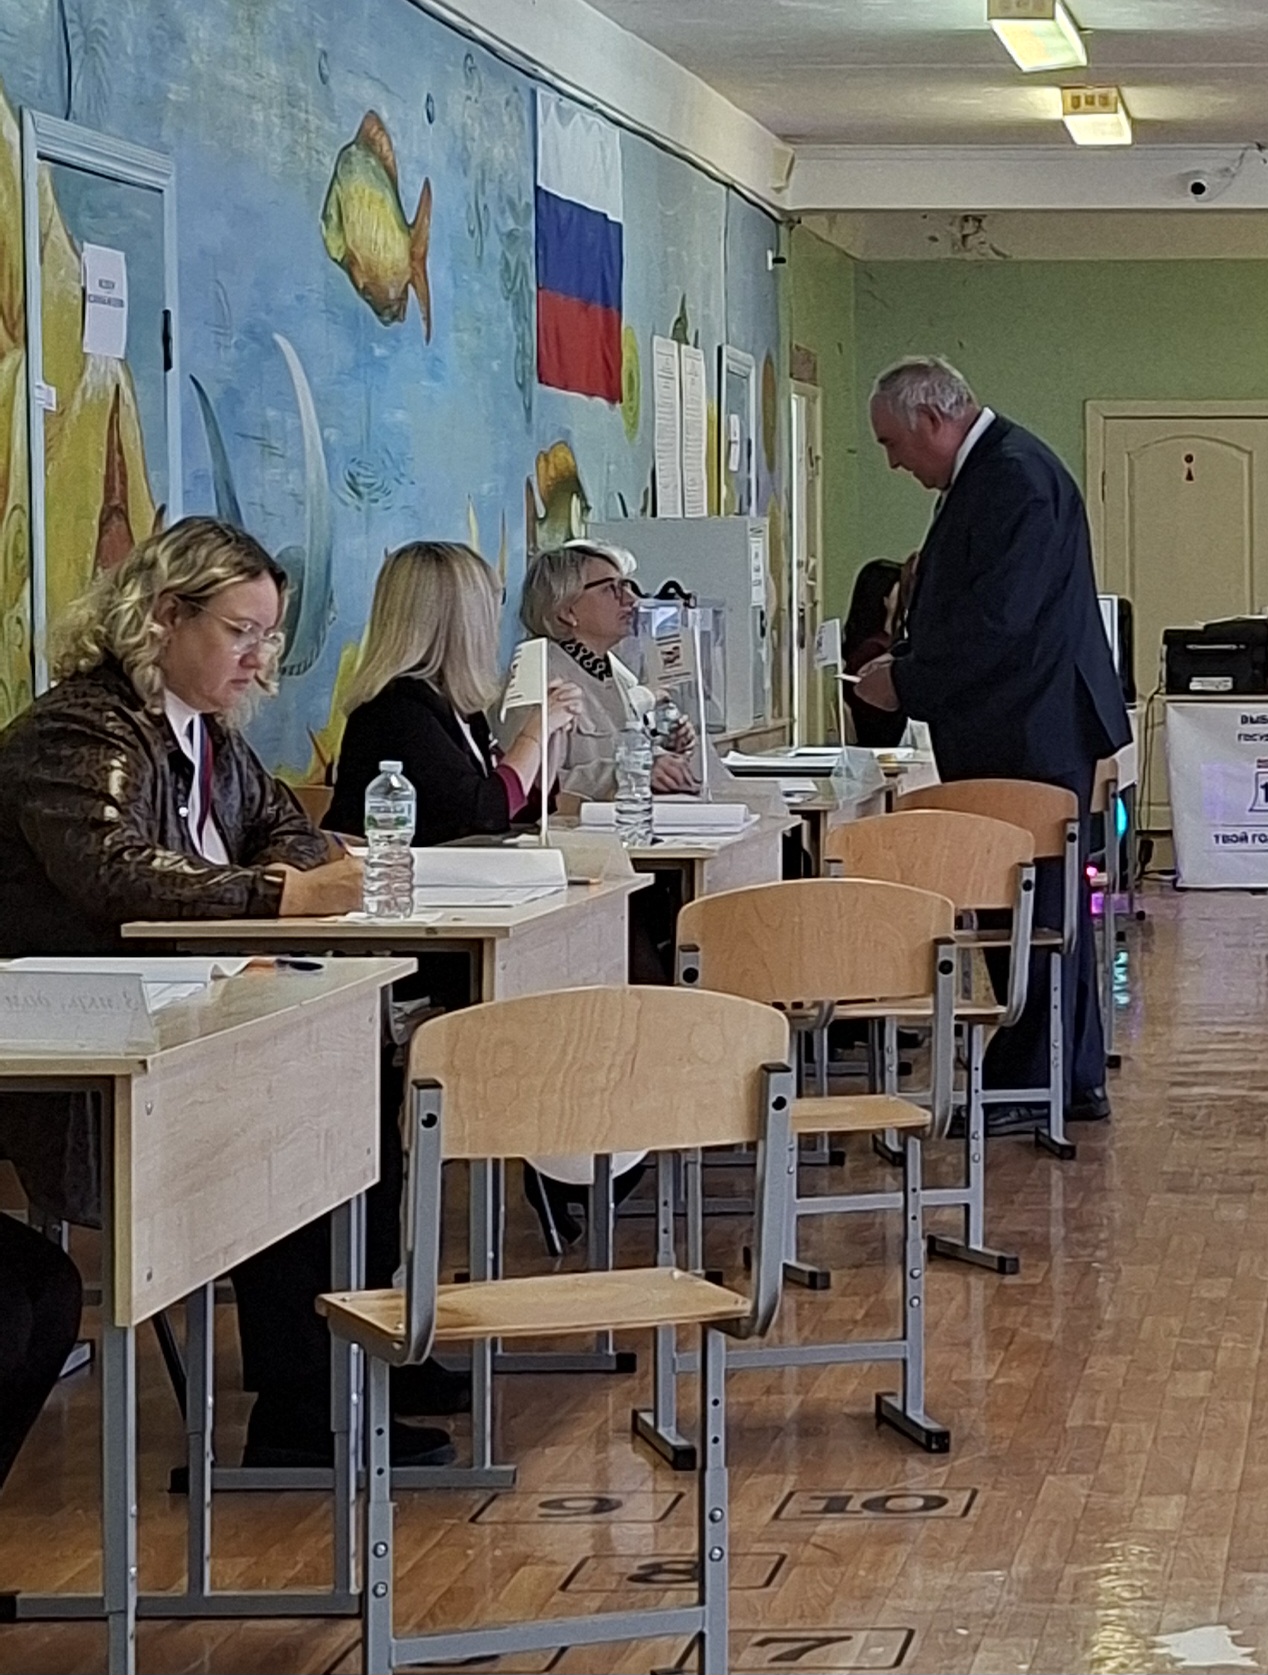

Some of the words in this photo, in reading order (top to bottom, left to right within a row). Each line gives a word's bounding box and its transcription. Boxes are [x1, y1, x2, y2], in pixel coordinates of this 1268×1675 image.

[1214, 831, 1249, 844] ТВОЙ
[538, 1495, 624, 1519] 9
[801, 1493, 950, 1515] 10
[750, 1636, 853, 1662] 7
